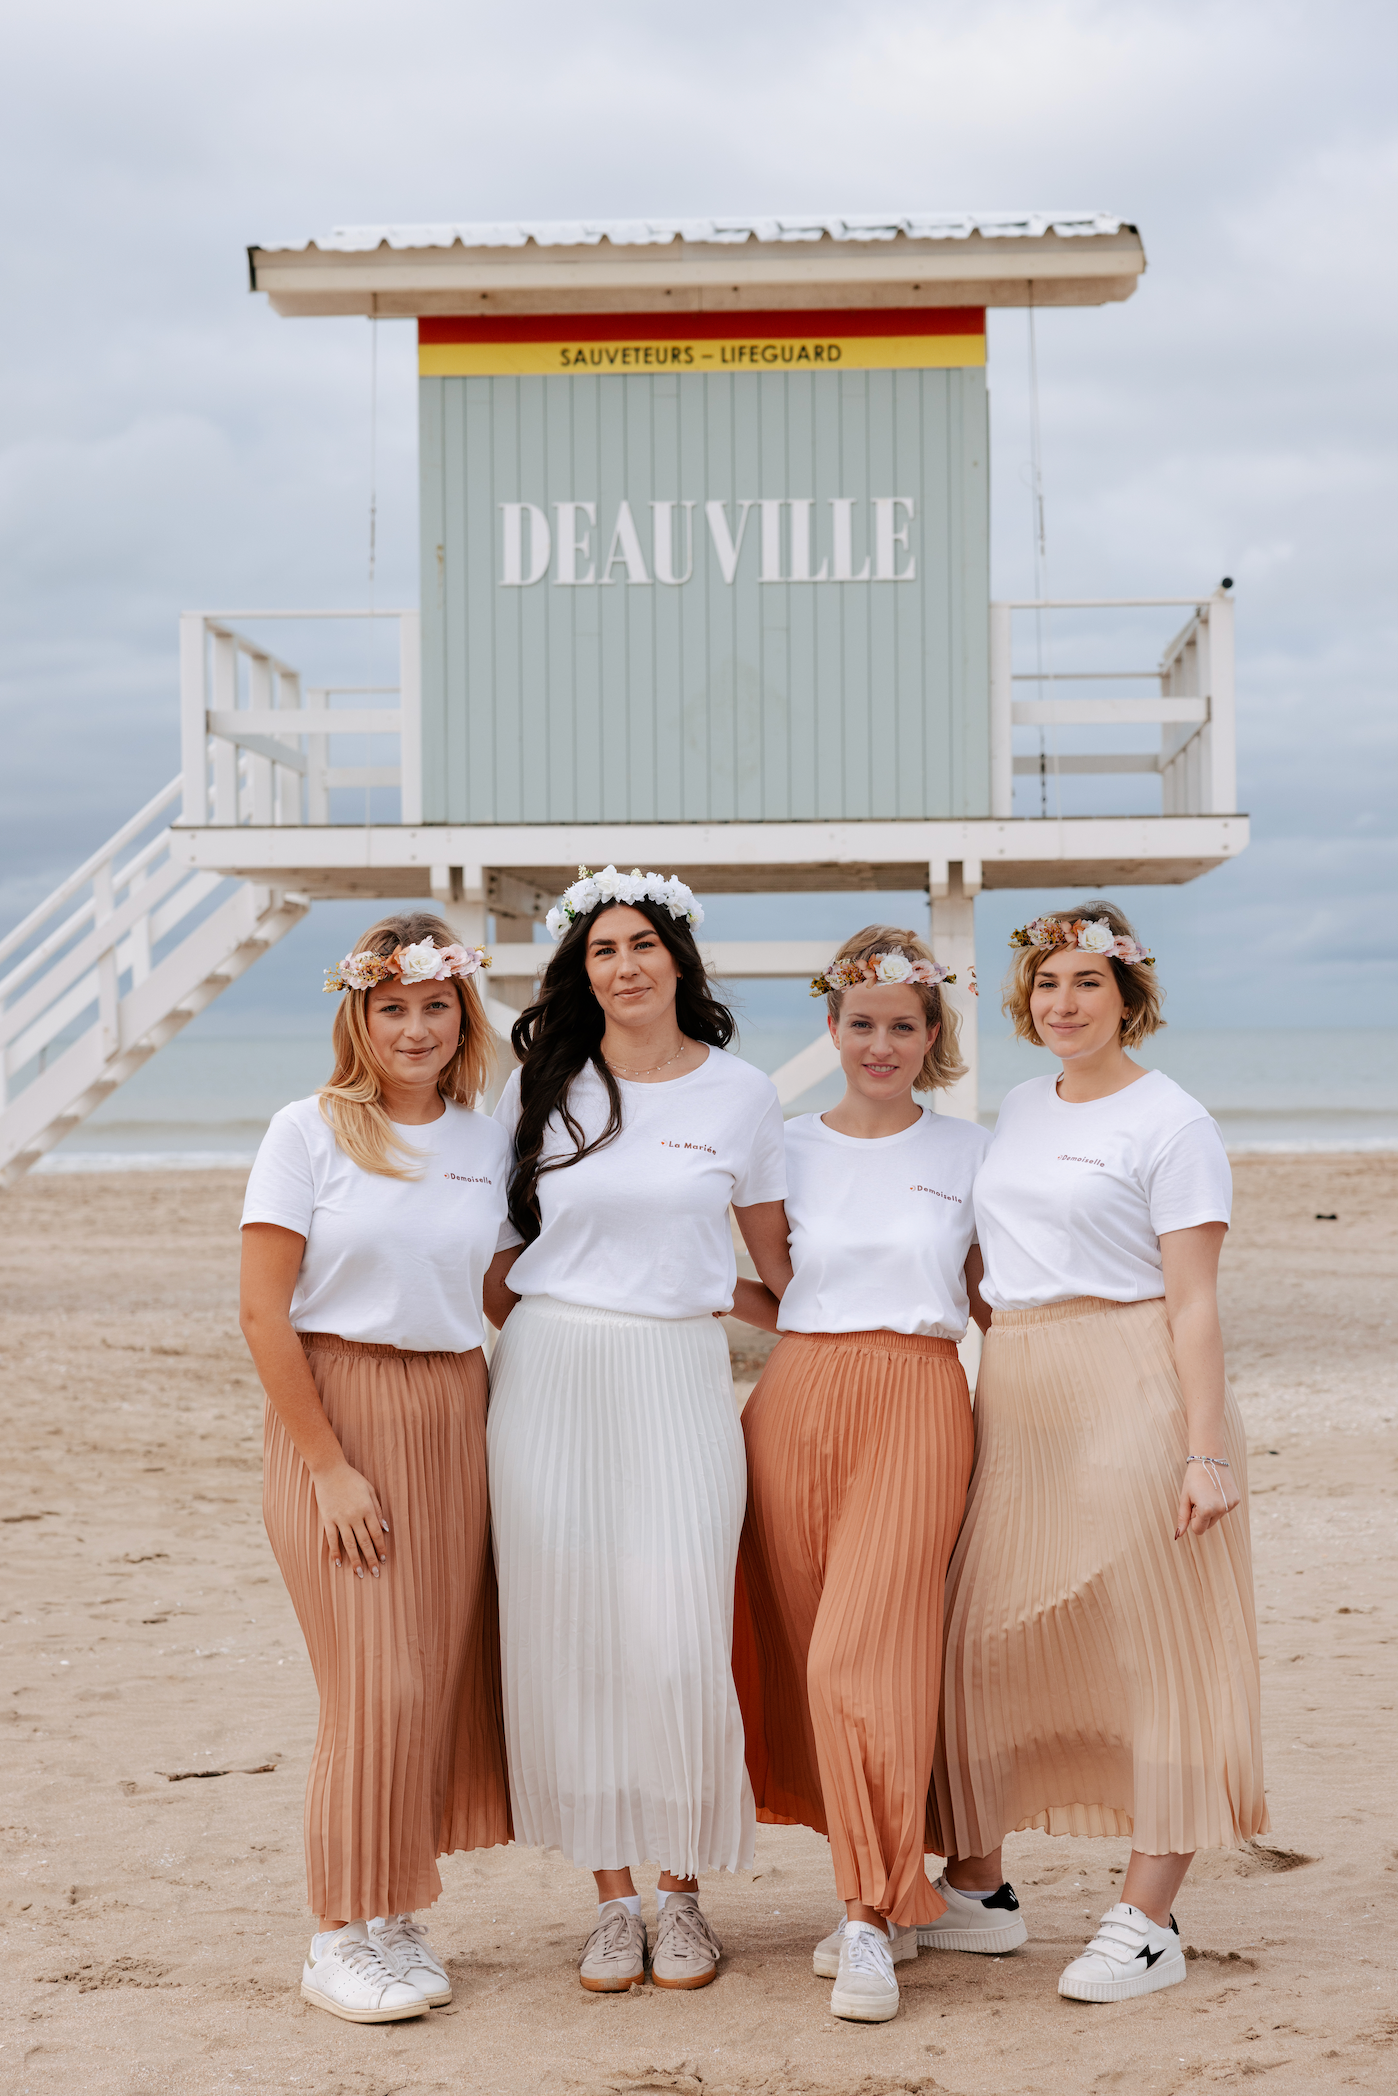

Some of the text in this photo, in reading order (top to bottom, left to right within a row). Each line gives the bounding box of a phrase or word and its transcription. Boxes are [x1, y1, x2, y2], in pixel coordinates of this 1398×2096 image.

[560, 347, 694, 366] SAUVETEURS
[721, 344, 842, 363] LIFEGUARD
[498, 498, 916, 586] DEAUVILLE
[669, 1140, 680, 1149] La
[1061, 1154, 1105, 1168] Demoiselle
[450, 1172, 492, 1185] Demoiselle
[917, 1185, 963, 1204] Demoiselle
